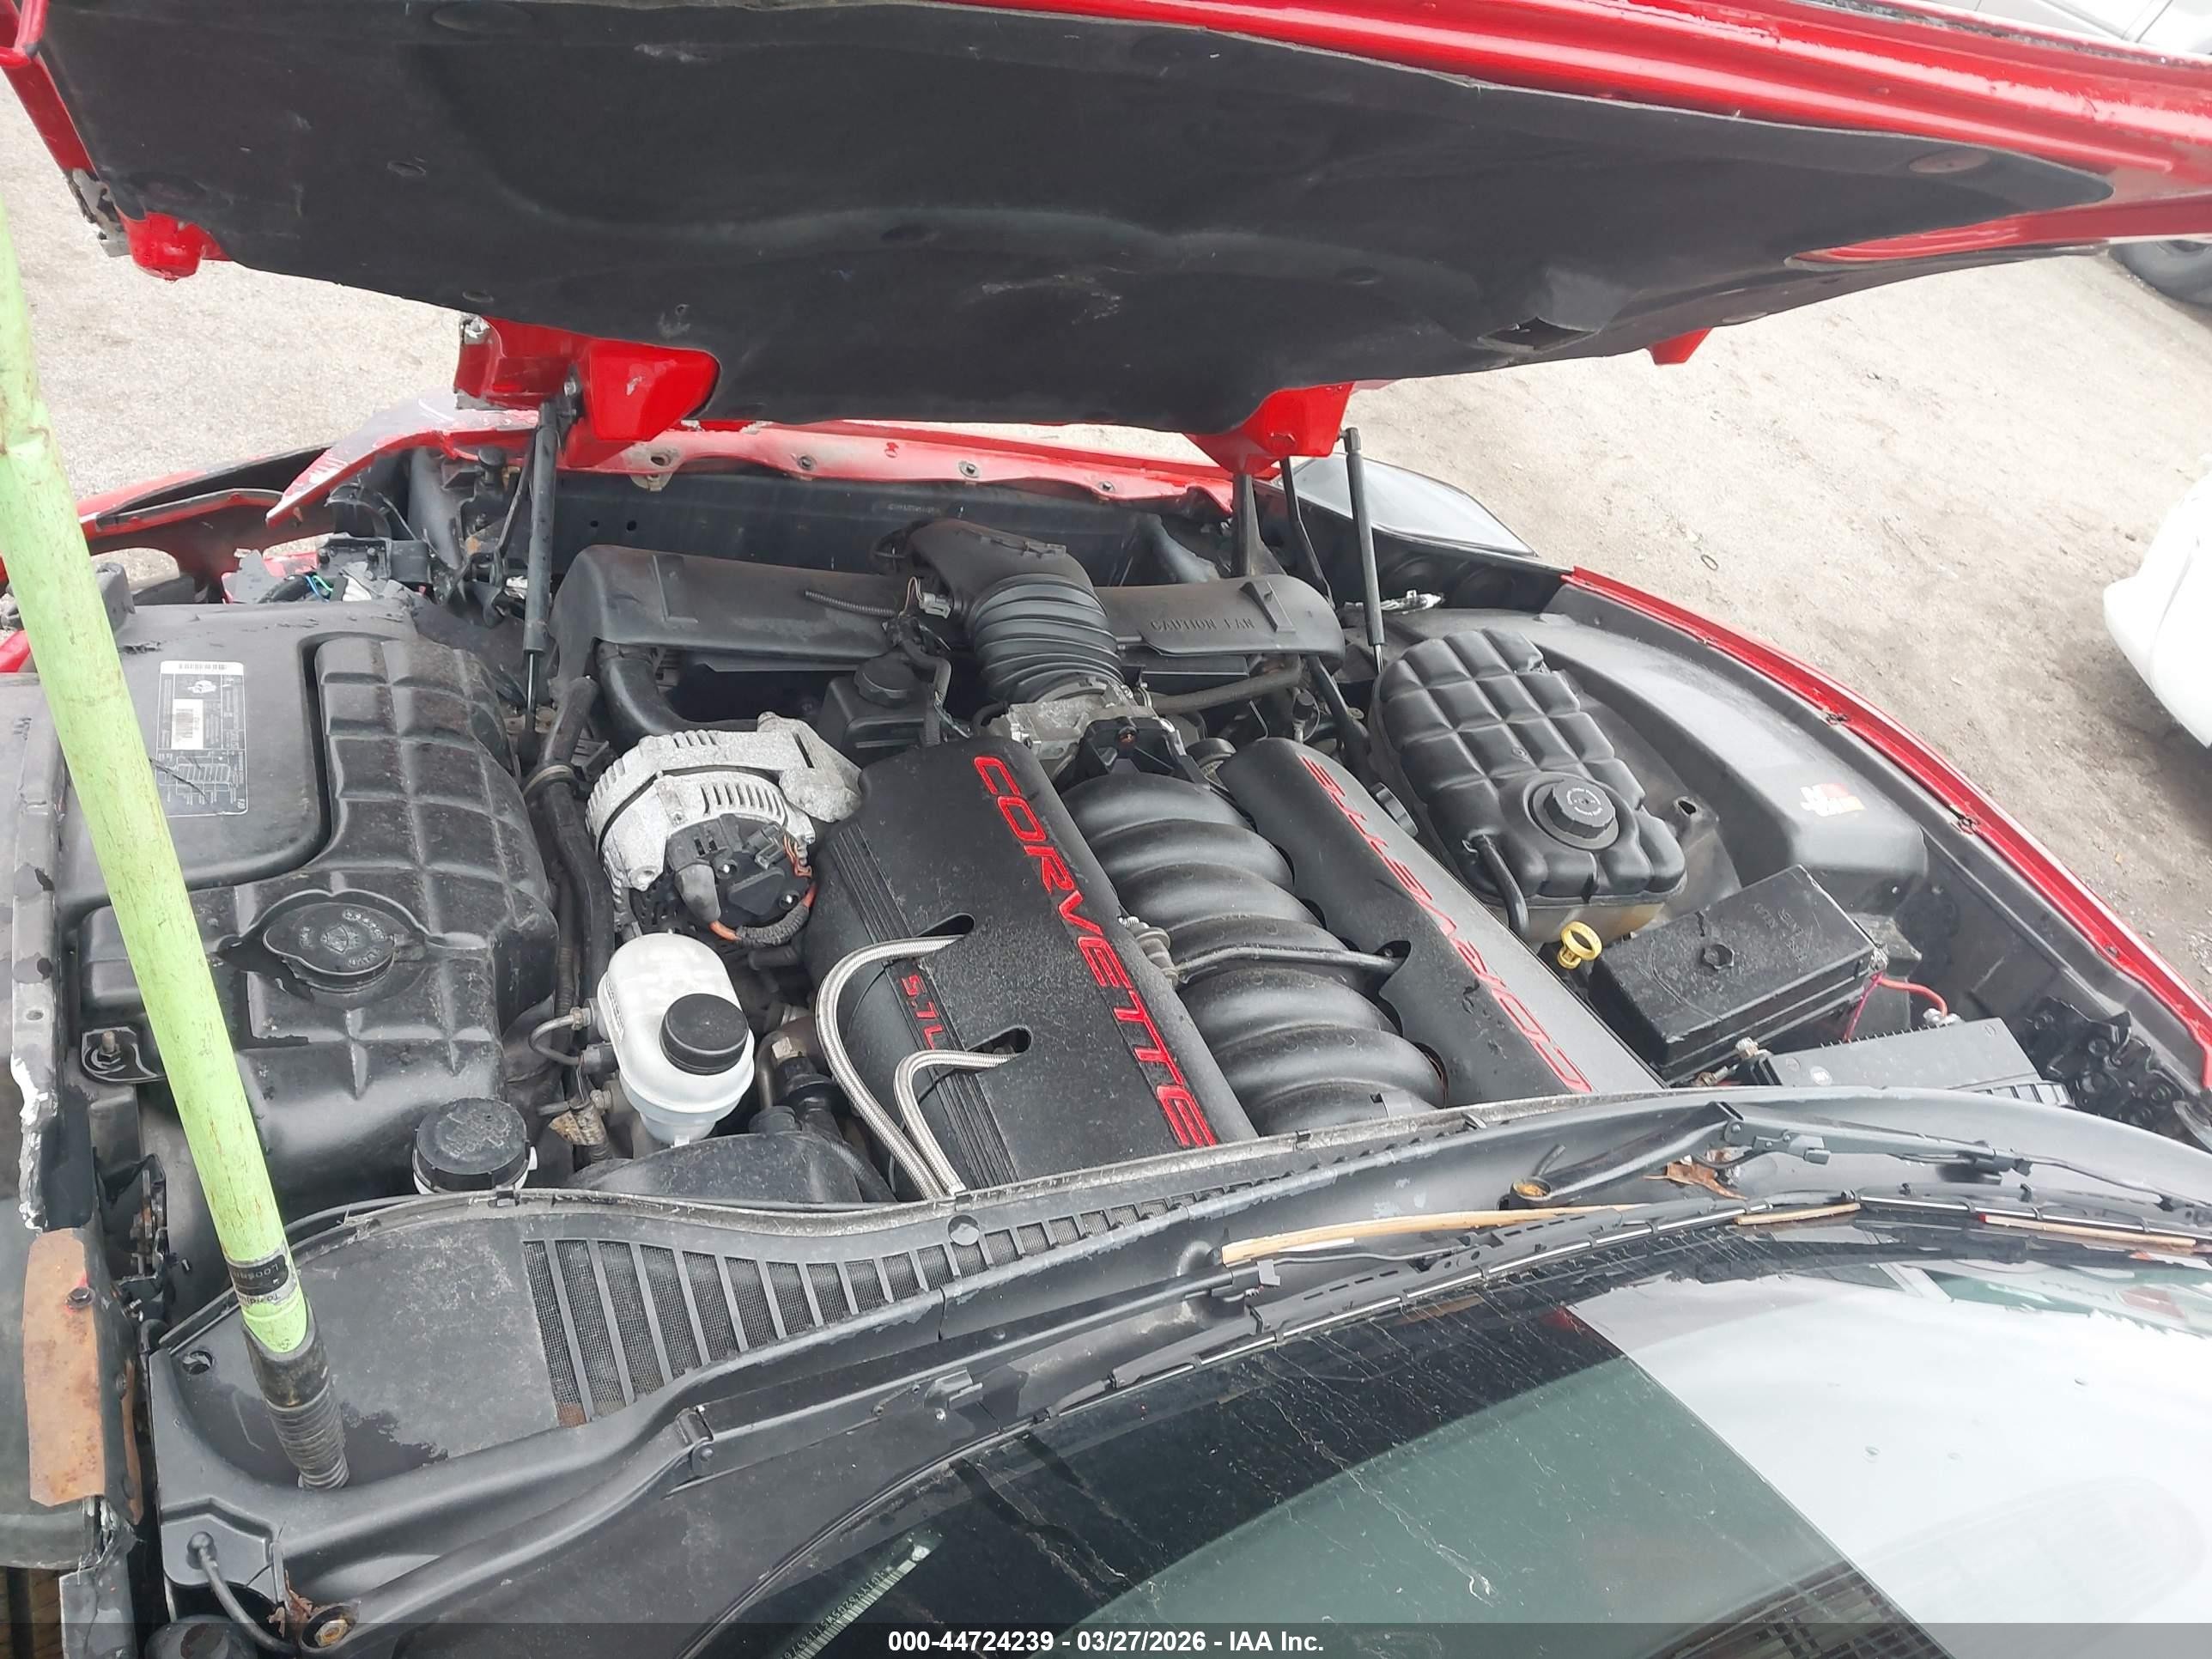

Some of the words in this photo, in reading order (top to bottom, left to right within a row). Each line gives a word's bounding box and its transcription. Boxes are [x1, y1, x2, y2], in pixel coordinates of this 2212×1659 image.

[901, 974, 944, 1050] 5.7L
[973, 756, 1218, 1148] CORVETTE
[1298, 755, 1593, 1093] CORVETTE
